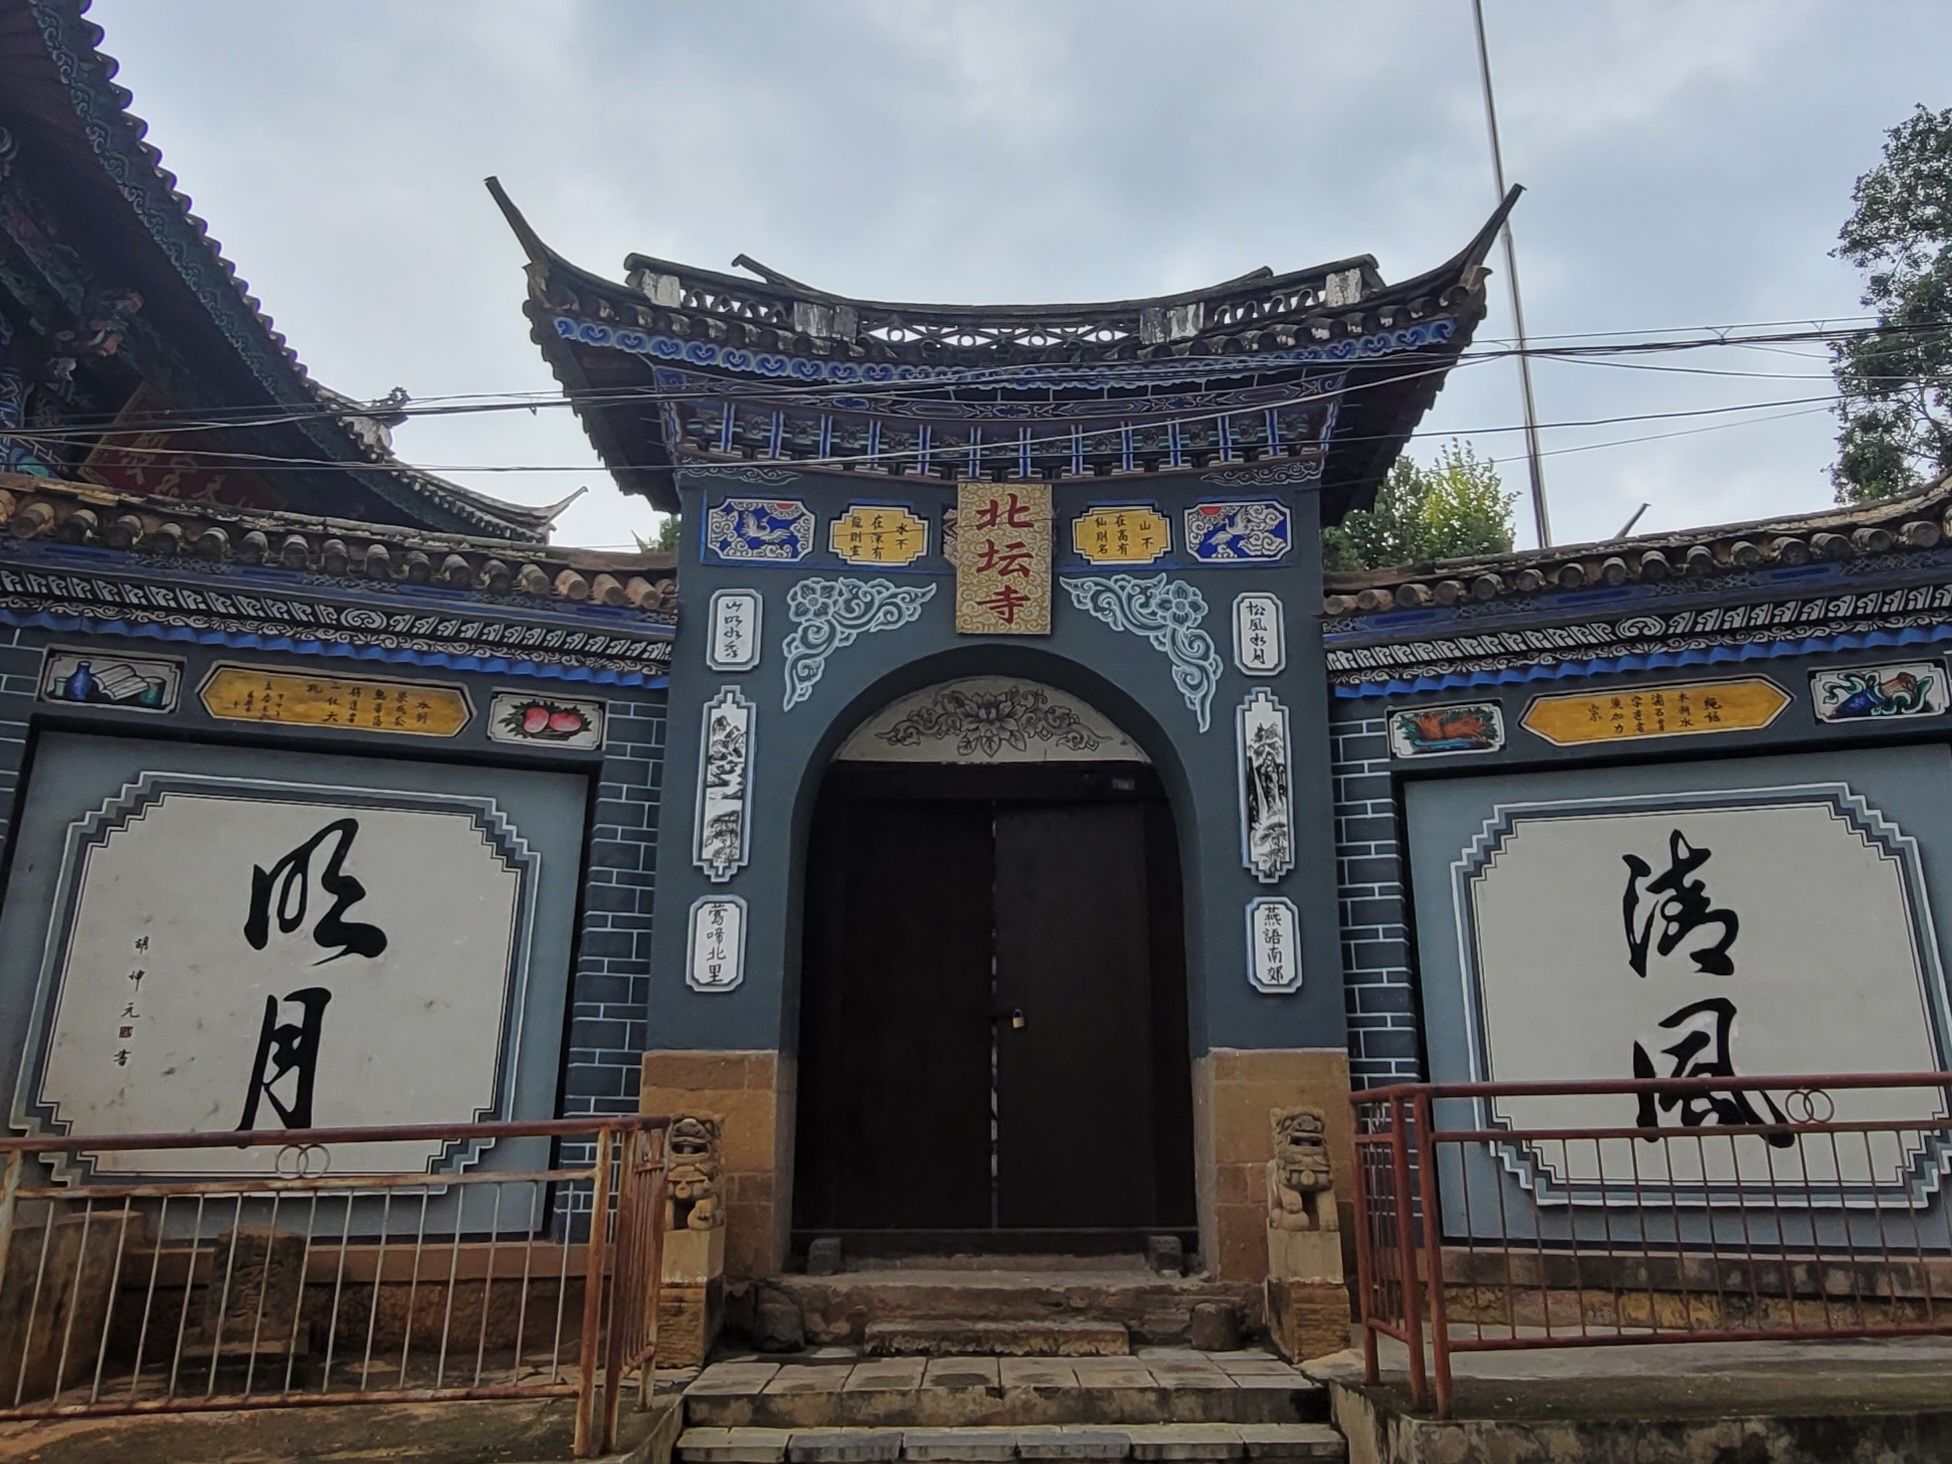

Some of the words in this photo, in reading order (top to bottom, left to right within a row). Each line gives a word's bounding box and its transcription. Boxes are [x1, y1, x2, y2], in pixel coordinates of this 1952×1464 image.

[975, 493, 1035, 624] 北坛寺
[234, 817, 388, 1149] 明月
